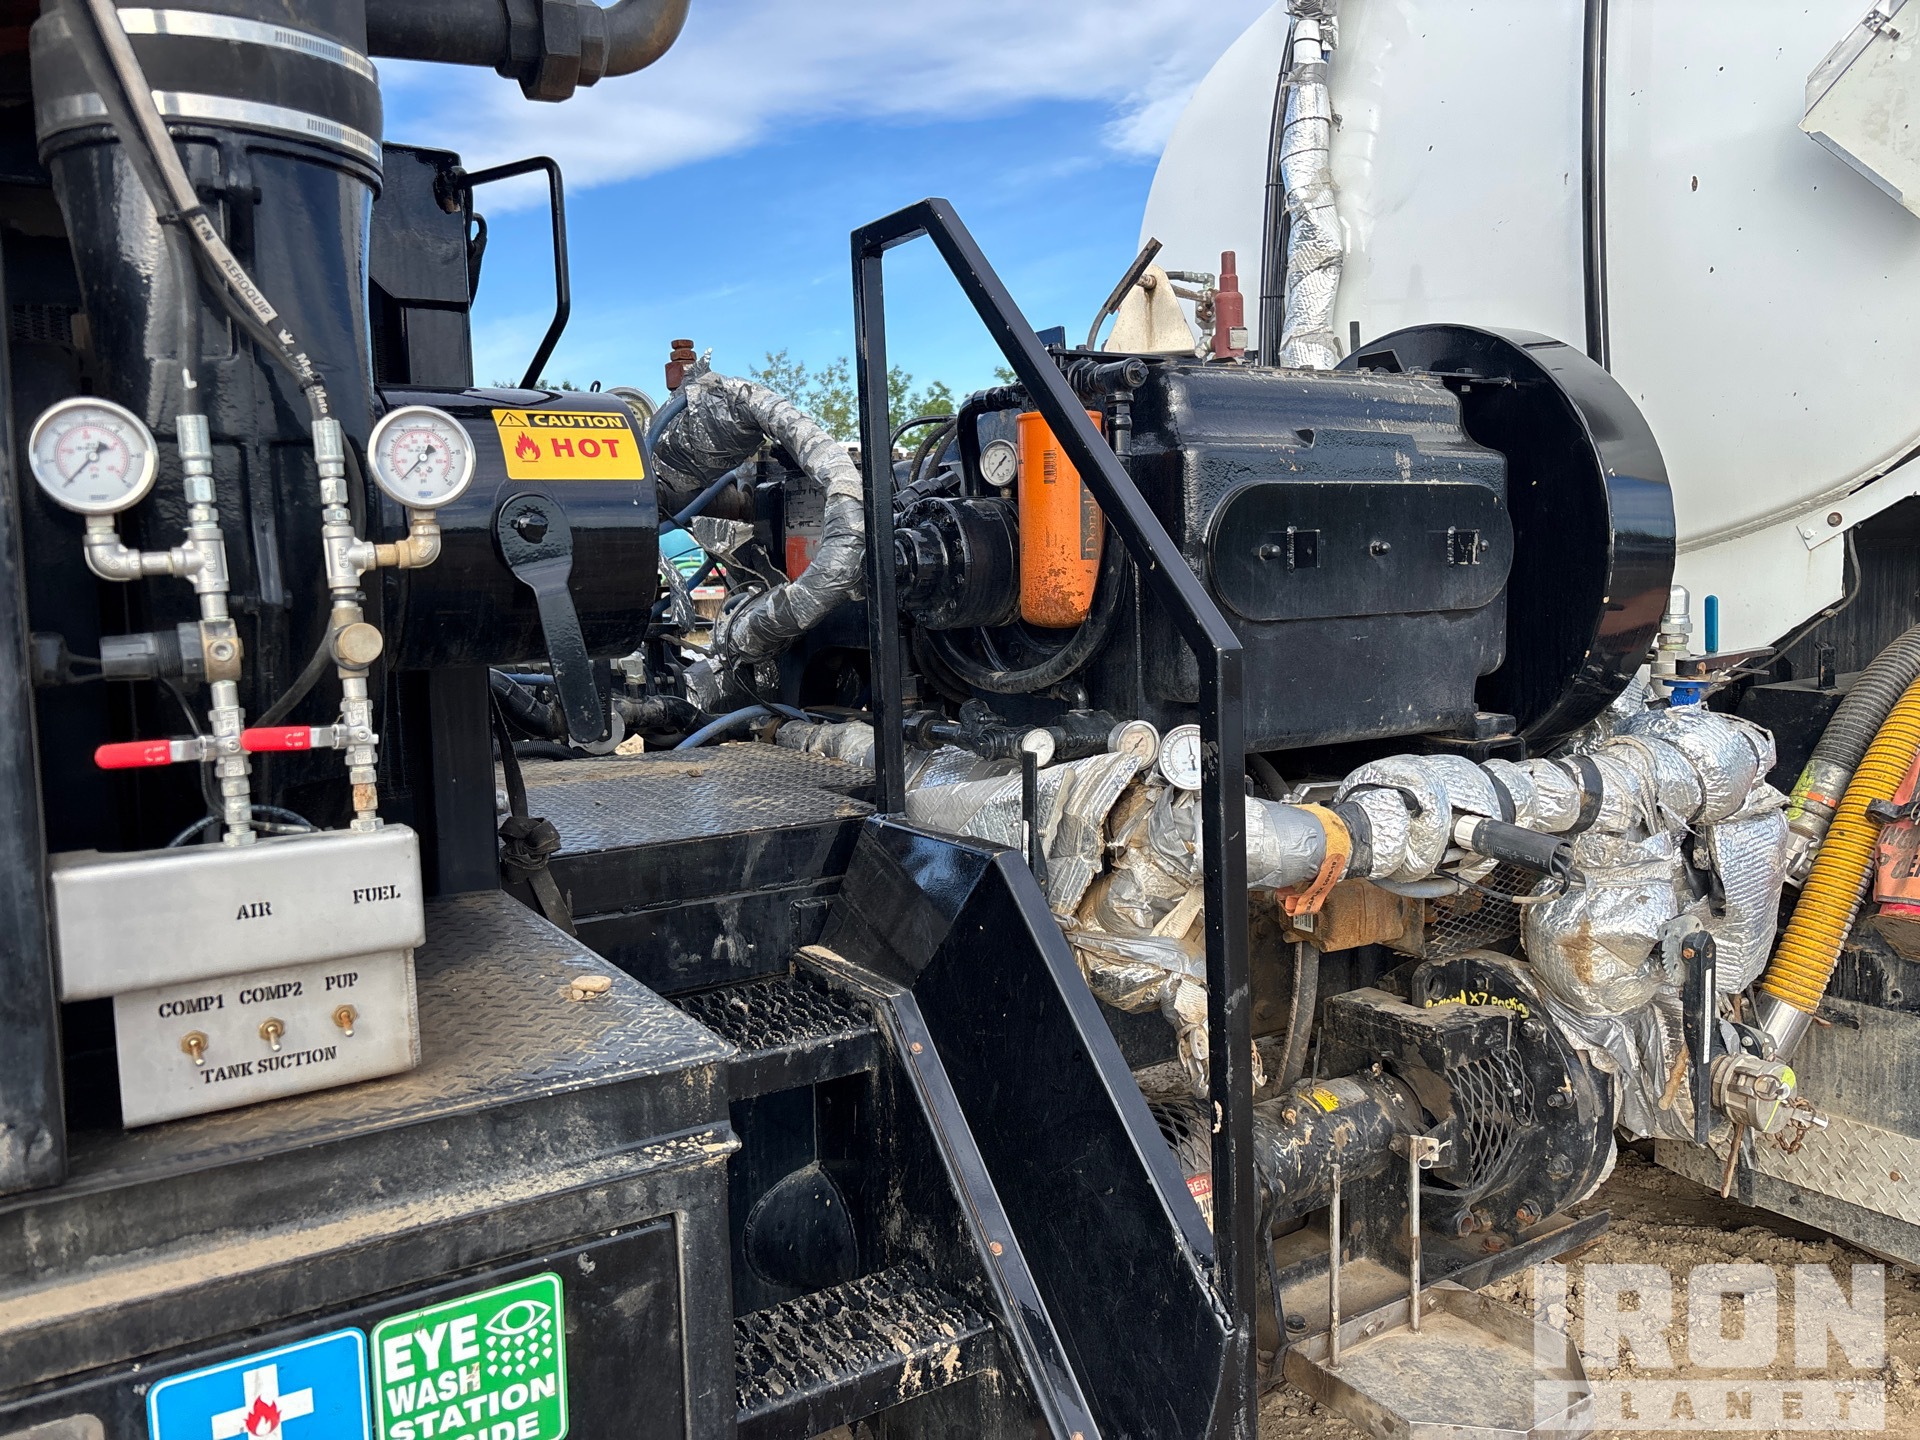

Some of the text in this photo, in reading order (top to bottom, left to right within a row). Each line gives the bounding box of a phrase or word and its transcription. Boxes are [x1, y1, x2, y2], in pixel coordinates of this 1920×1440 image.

[221, 258, 271, 316] AEROQUIP
[533, 415, 624, 428] CAUTION
[550, 438, 620, 458] HOT
[236, 901, 273, 920] AIR
[353, 884, 401, 904] FUEL
[158, 972, 358, 1018] COMP1 COMP2 PUP
[200, 1046, 338, 1084] TANK SUCTION
[383, 1313, 480, 1384] EYE
[386, 1362, 481, 1418] WASH
[389, 1372, 556, 1440] STATION
